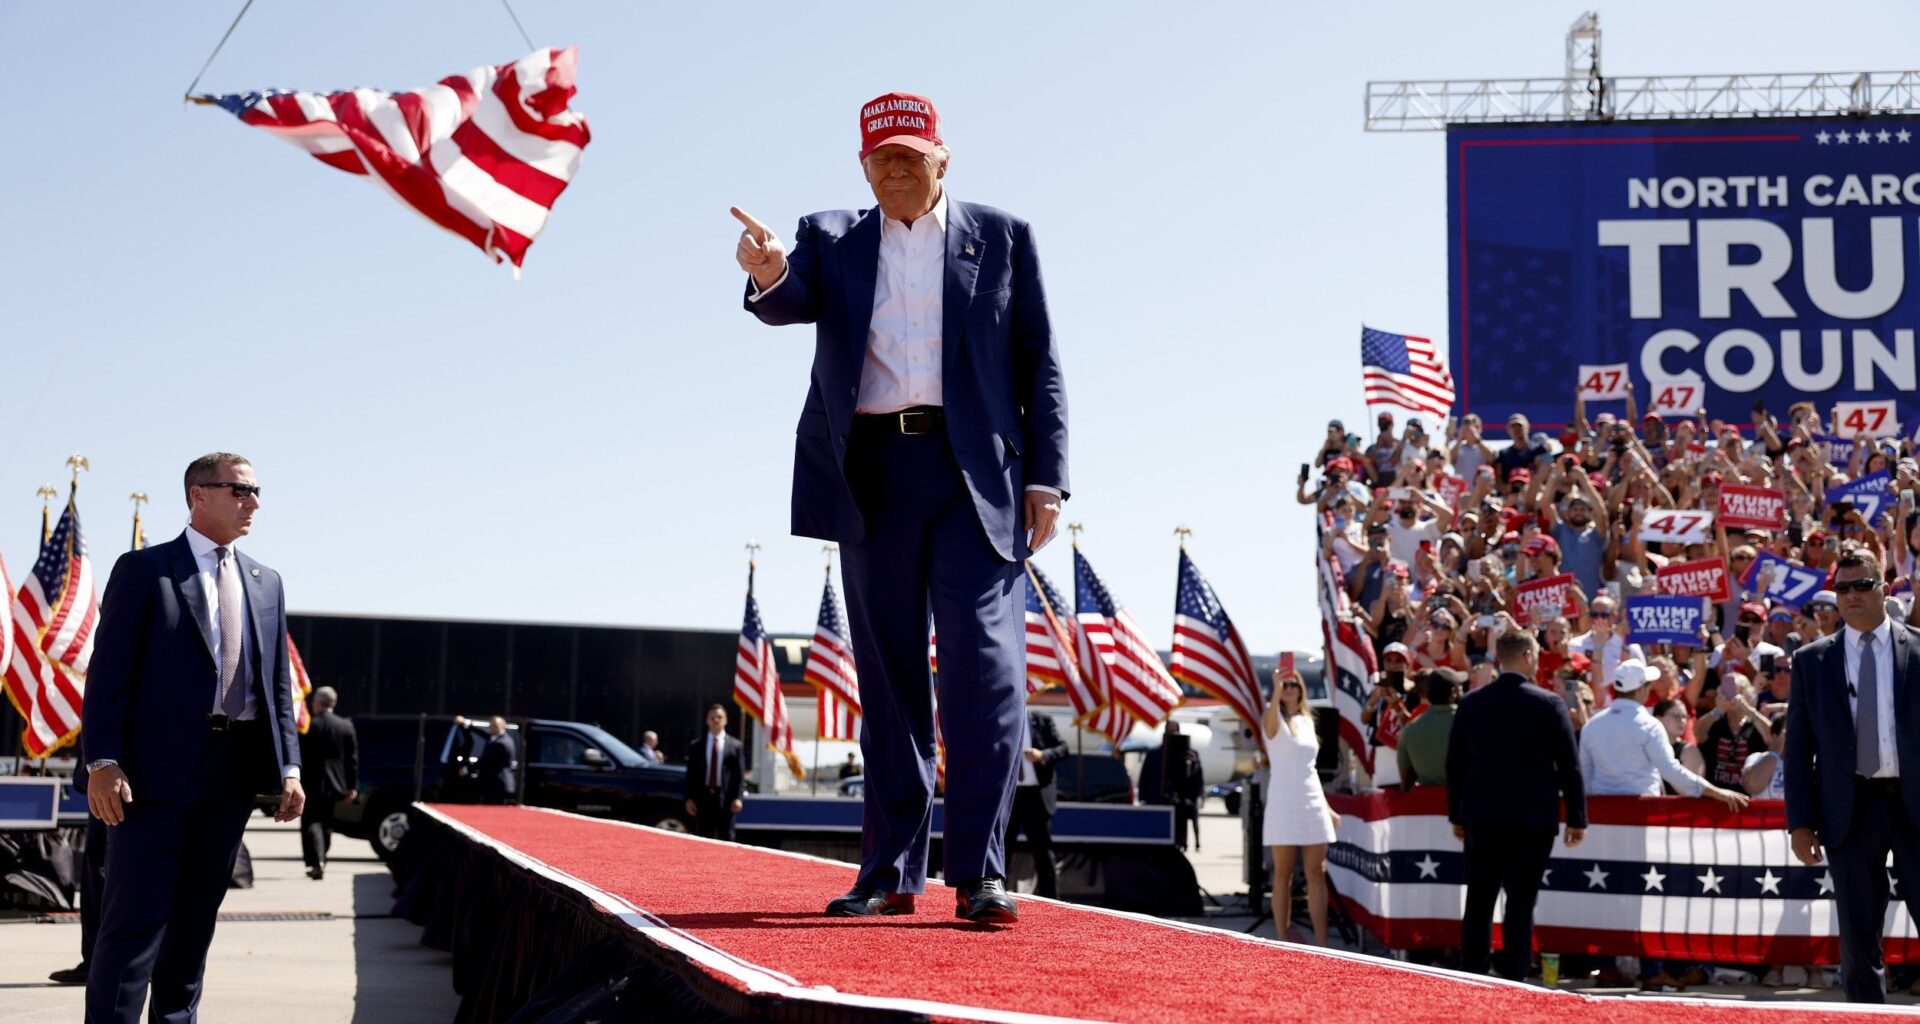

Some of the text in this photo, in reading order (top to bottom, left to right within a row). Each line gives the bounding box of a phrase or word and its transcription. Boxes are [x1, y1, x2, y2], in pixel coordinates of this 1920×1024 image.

[863, 99, 930, 119] MAKE AMERICA
[867, 115, 926, 133] GREAT AGAIN
[1628, 175, 1788, 208] NORTH
[1598, 216, 1920, 319] TRU
[1640, 328, 1917, 393] COUN
[1585, 370, 1622, 393] 47
[1657, 386, 1694, 409] 47
[1844, 407, 1888, 433] 47
[1722, 493, 1783, 508] TRUMP
[1727, 503, 1776, 518] VANCE
[1649, 515, 1702, 535] 47
[1659, 568, 1723, 587] TRUMP
[1630, 606, 1699, 620] TRUMP
[1636, 618, 1692, 630] VANCE
